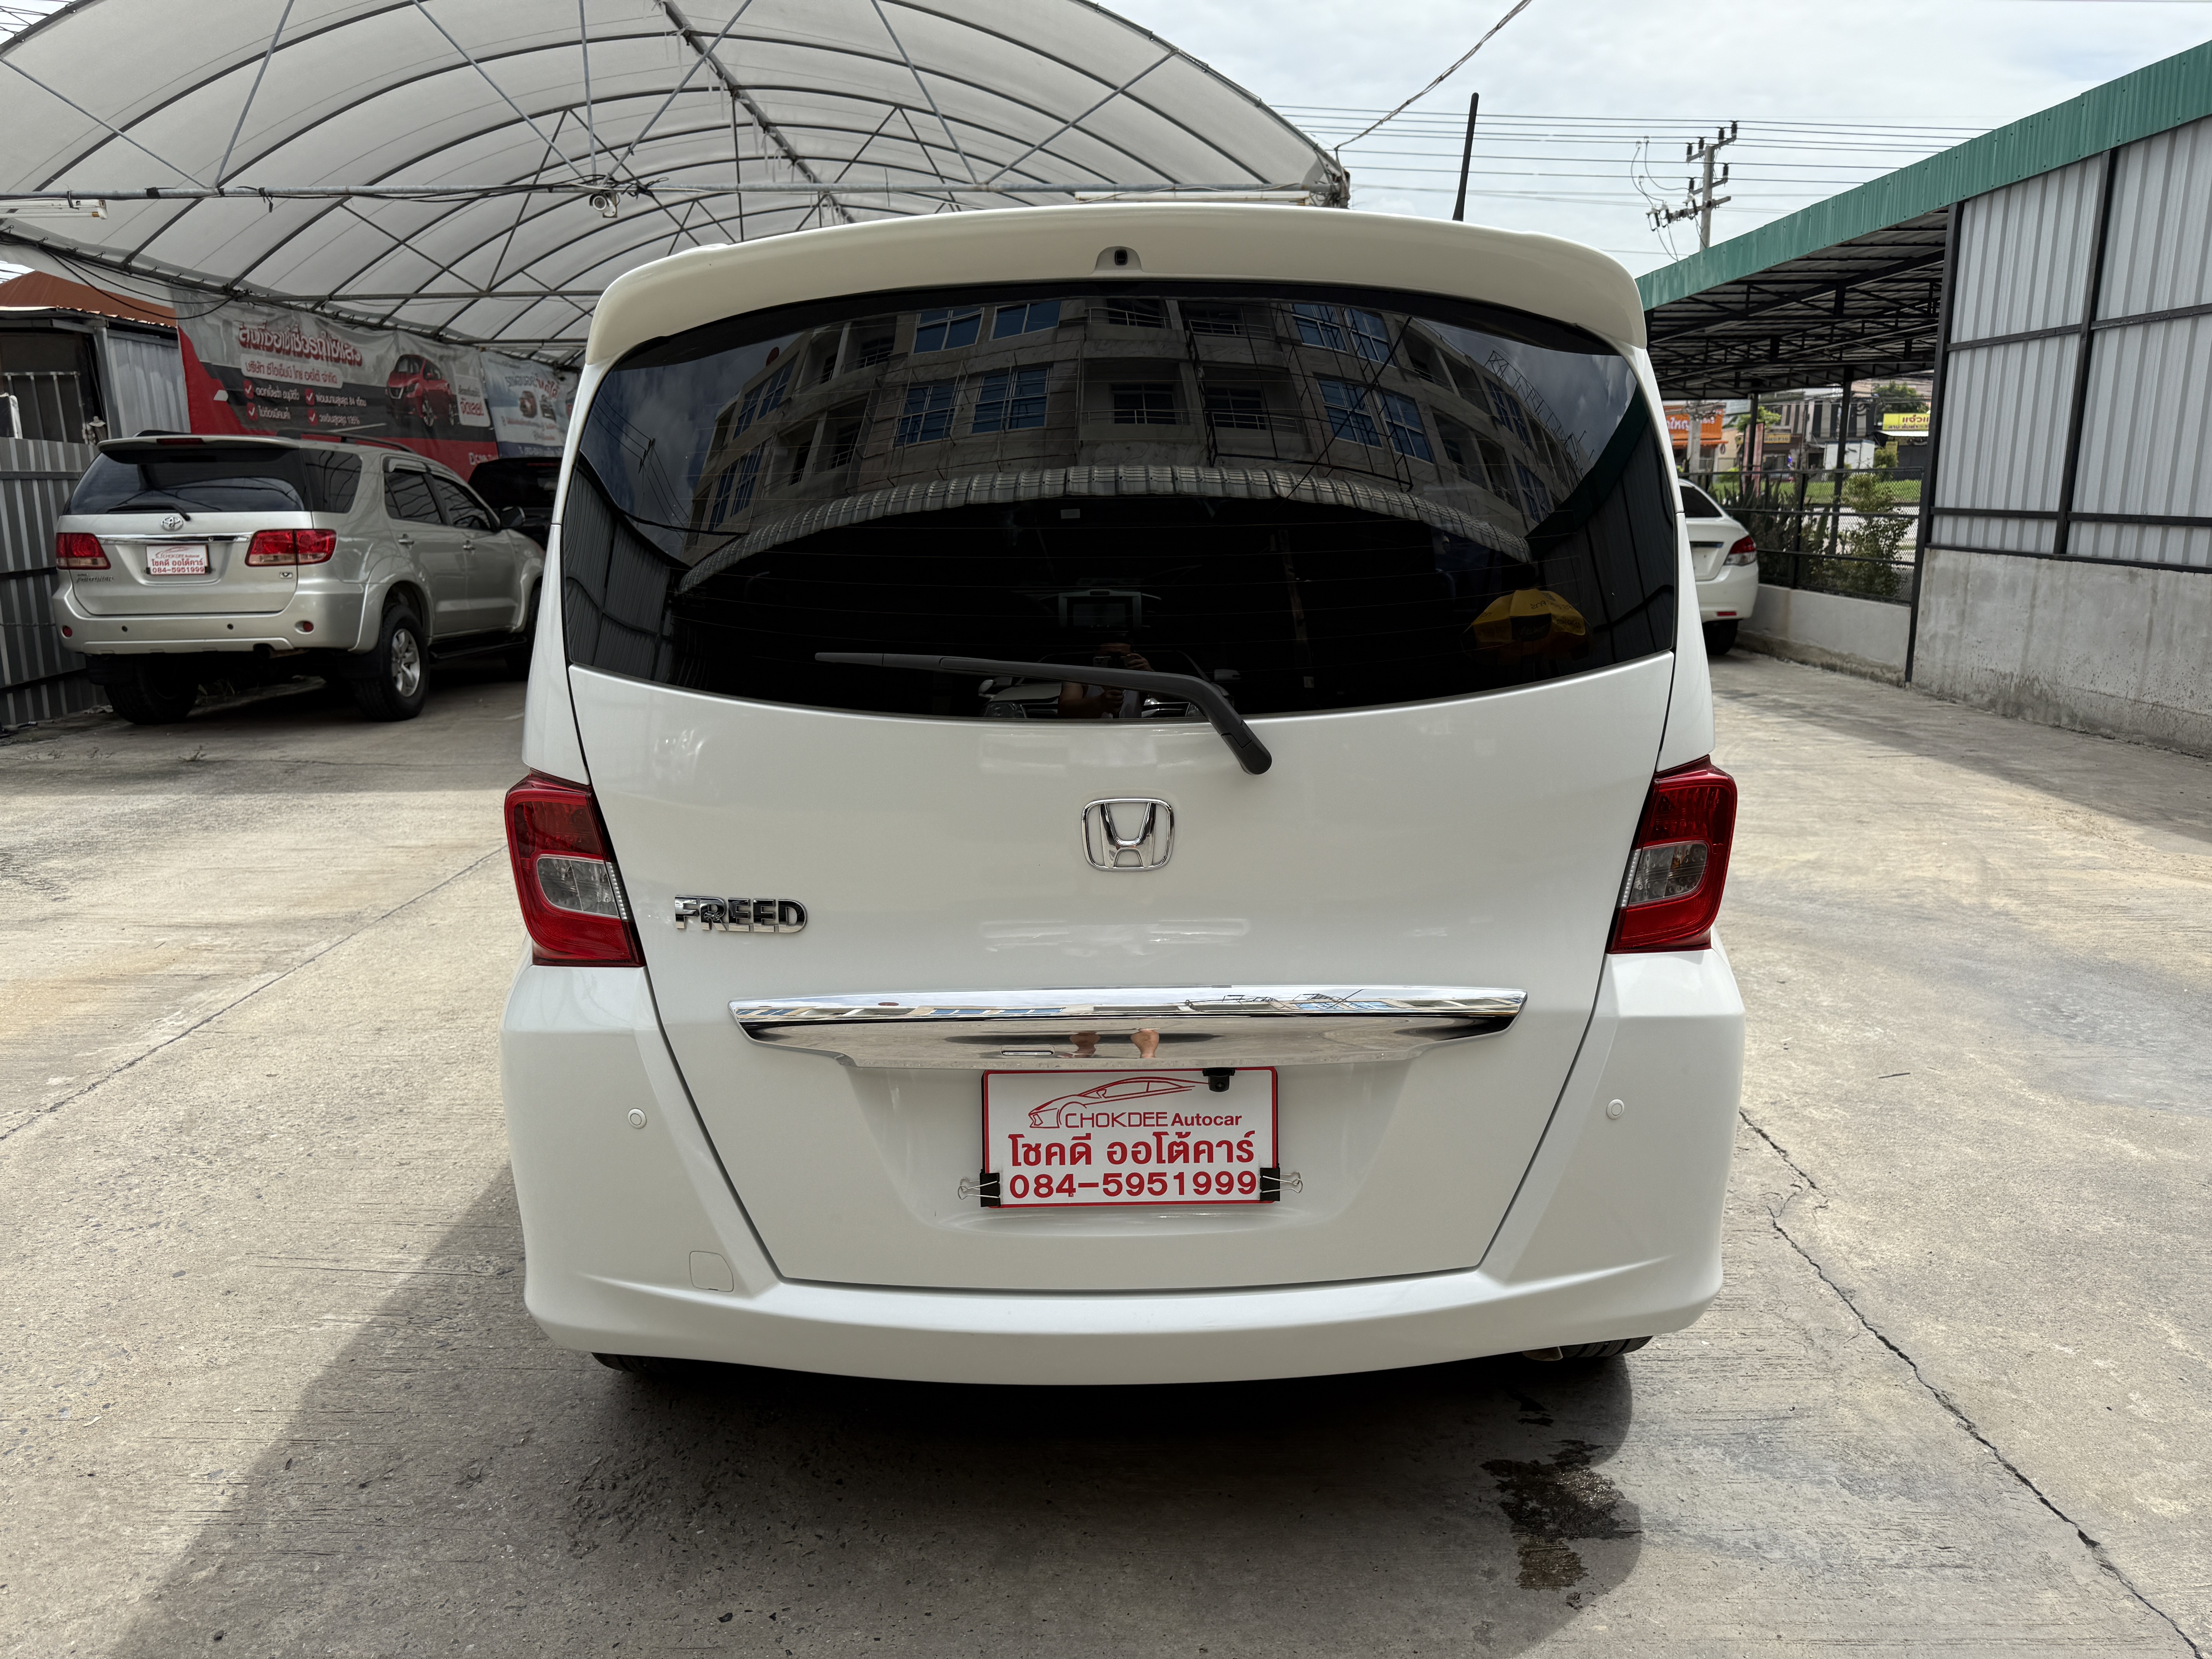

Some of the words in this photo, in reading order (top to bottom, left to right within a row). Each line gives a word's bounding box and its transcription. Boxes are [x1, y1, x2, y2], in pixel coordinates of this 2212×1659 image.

[151, 558, 170, 567] โชคดี
[172, 558, 203, 566] ออโต้คาร์
[675, 896, 807, 933] FREED
[1065, 1112, 1168, 1128] CHOKDEE
[1171, 1113, 1242, 1127] Autocar
[1008, 1133, 1092, 1166] โชคดี
[1107, 1130, 1255, 1164] ออโต้คาร์
[1010, 1171, 1256, 1199] 084-5951999
